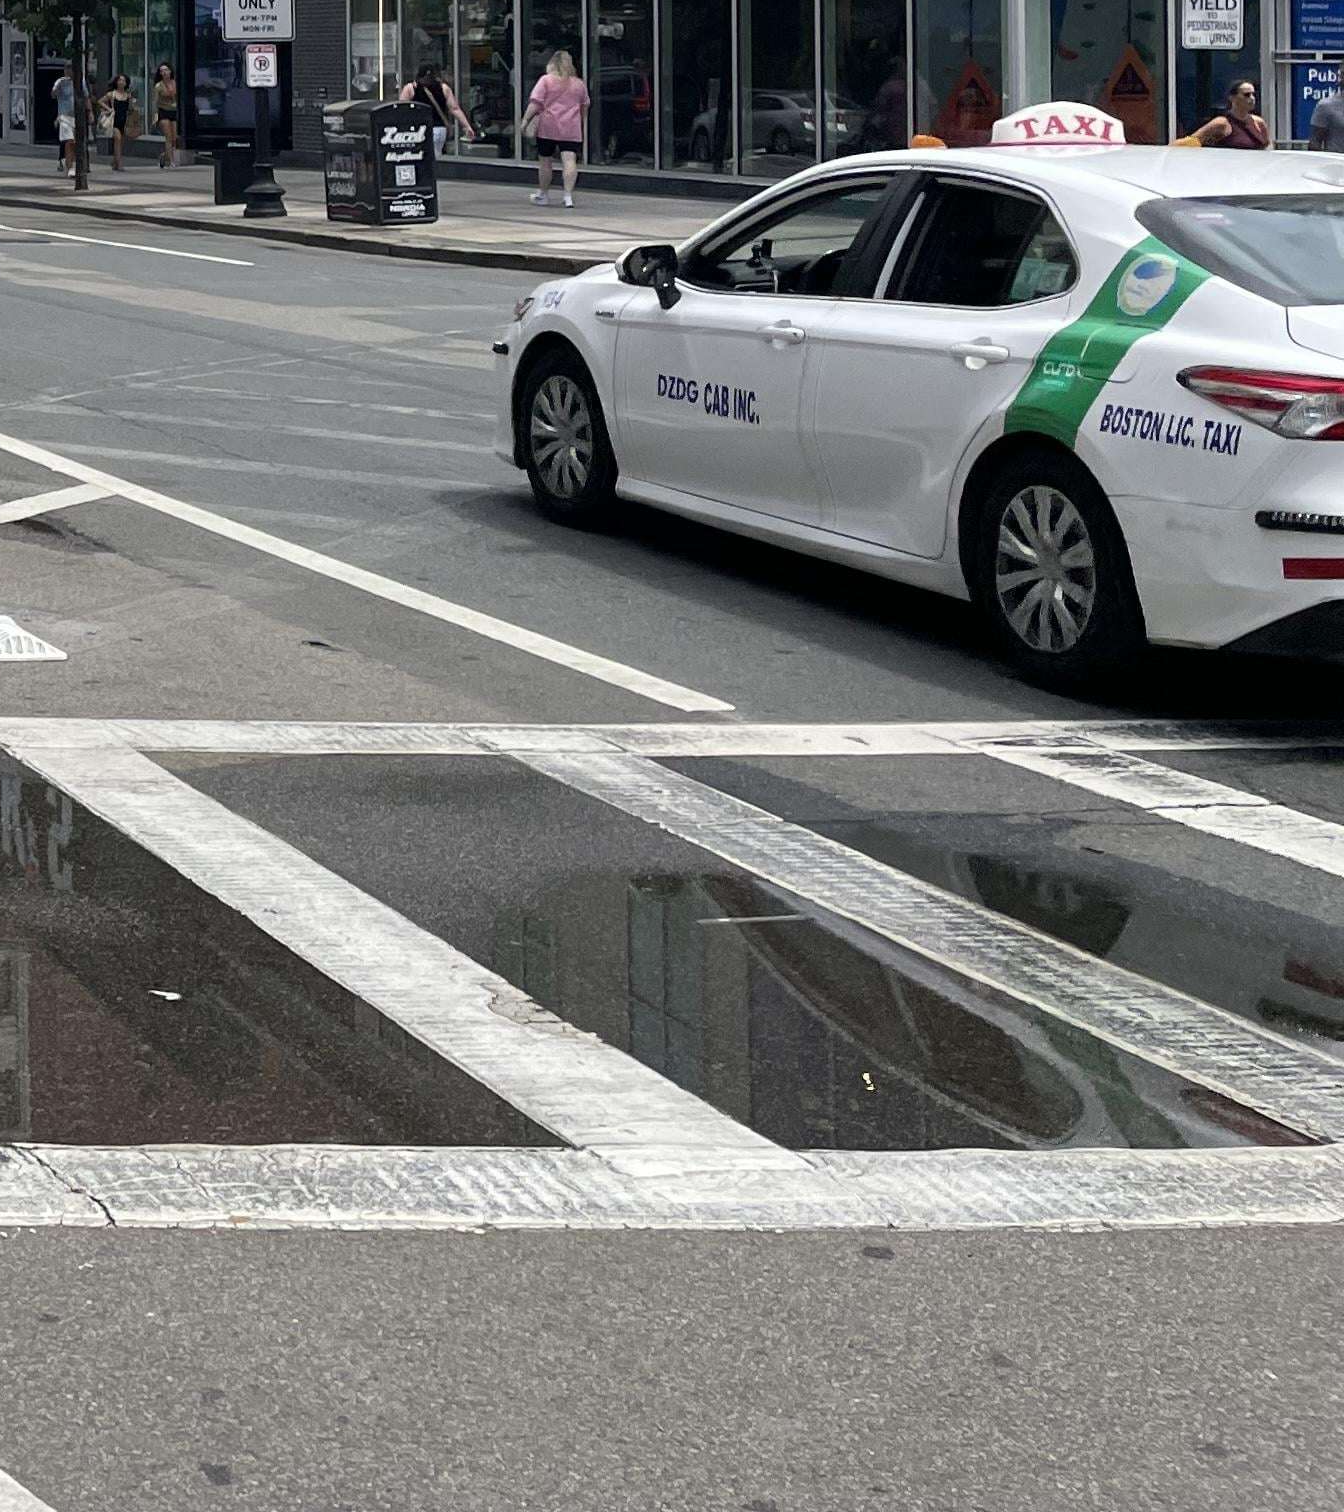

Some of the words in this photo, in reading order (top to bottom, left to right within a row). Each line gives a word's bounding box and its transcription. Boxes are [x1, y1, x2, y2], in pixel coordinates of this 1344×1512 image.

[1015, 111, 1115, 144] TAXI
[657, 373, 699, 404] DZDG
[704, 383, 730, 418] CAB
[733, 388, 760, 425] INC.
[1099, 404, 1165, 442] BOSTON
[1166, 414, 1195, 448] LIC.
[1202, 420, 1242, 456] TAXI
